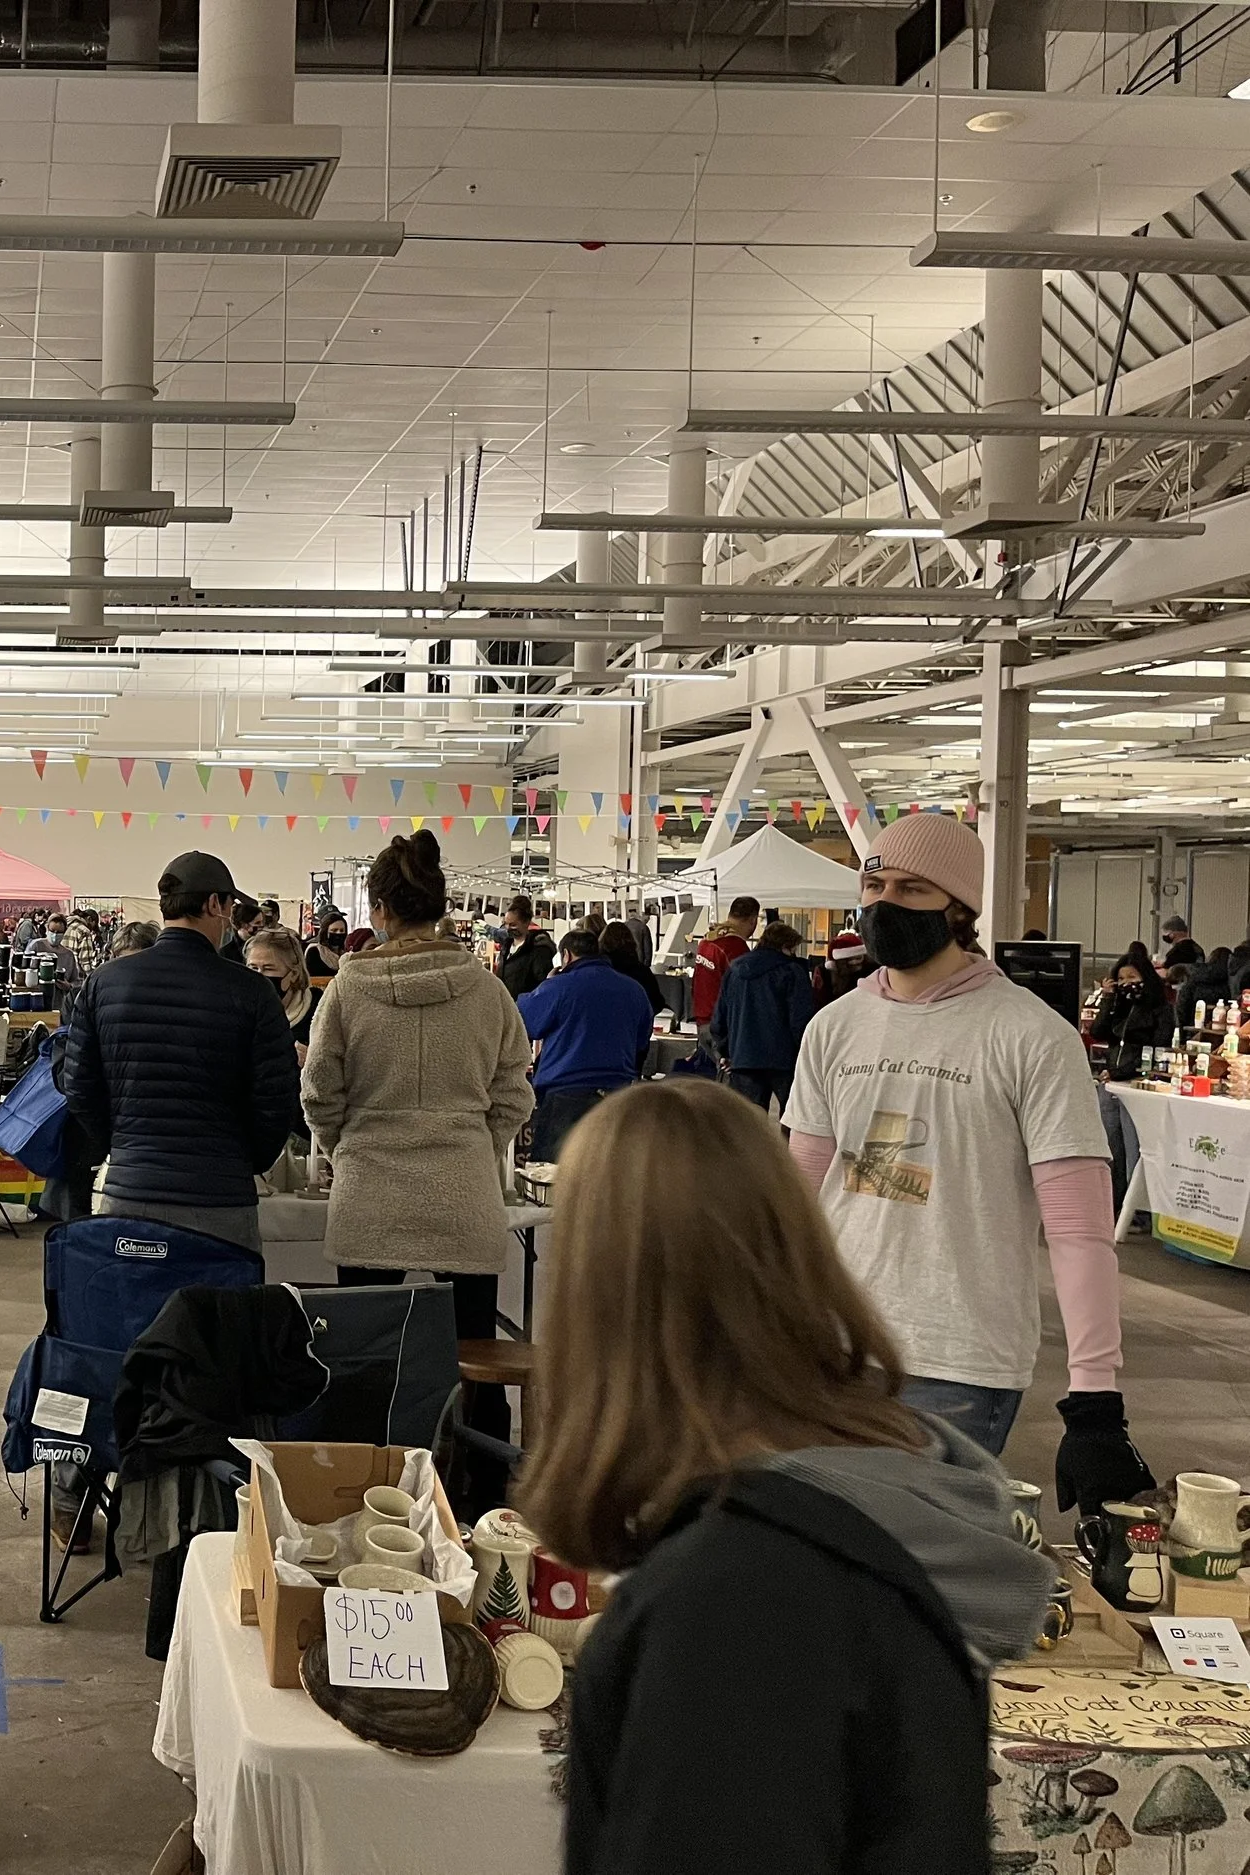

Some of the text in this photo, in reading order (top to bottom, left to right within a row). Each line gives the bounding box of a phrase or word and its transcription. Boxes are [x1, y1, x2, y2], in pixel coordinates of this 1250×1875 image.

[839, 1058, 973, 1085] Sunny Cat Ceramics
[119, 1240, 156, 1253] Coleman
[35, 1442, 72, 1462] Coleman
[1187, 1629, 1225, 1640] Square
[349, 1646, 425, 1682] EACH
[995, 1701, 1069, 1717] unny
[1063, 1695, 1126, 1712] Cat
